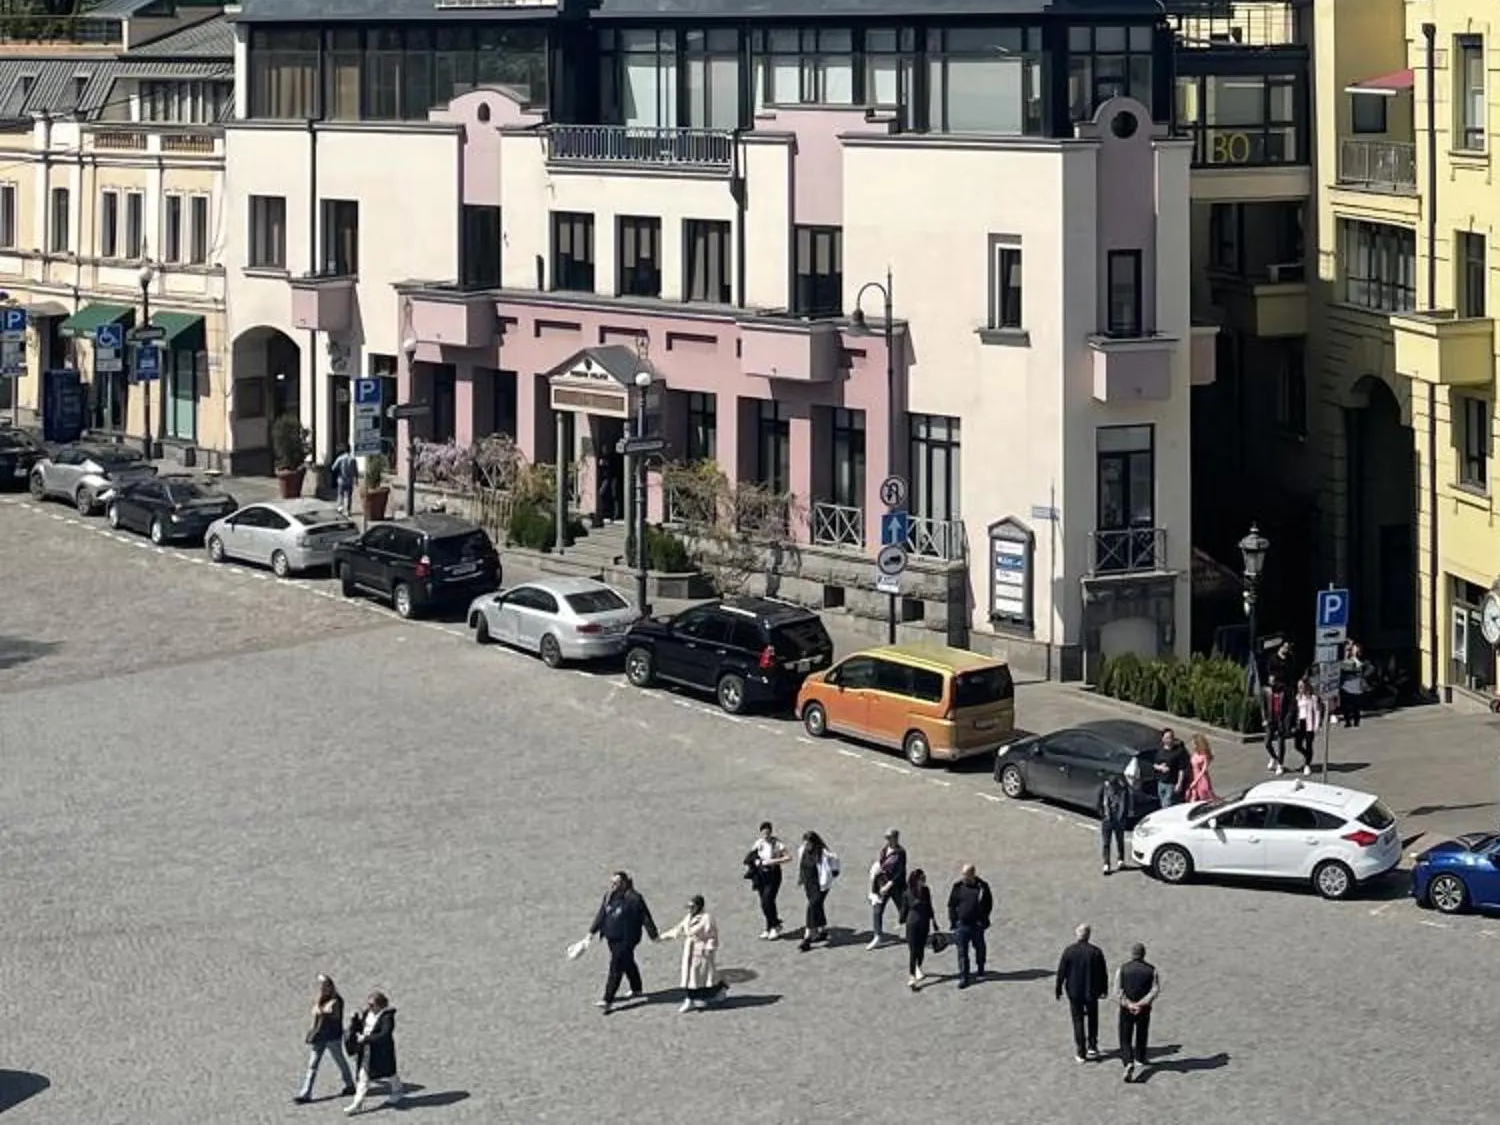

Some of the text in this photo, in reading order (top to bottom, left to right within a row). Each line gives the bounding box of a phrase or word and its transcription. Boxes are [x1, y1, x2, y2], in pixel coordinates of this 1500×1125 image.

[7, 313, 21, 329] P
[359, 380, 376, 402] P
[1323, 594, 1342, 624] P
